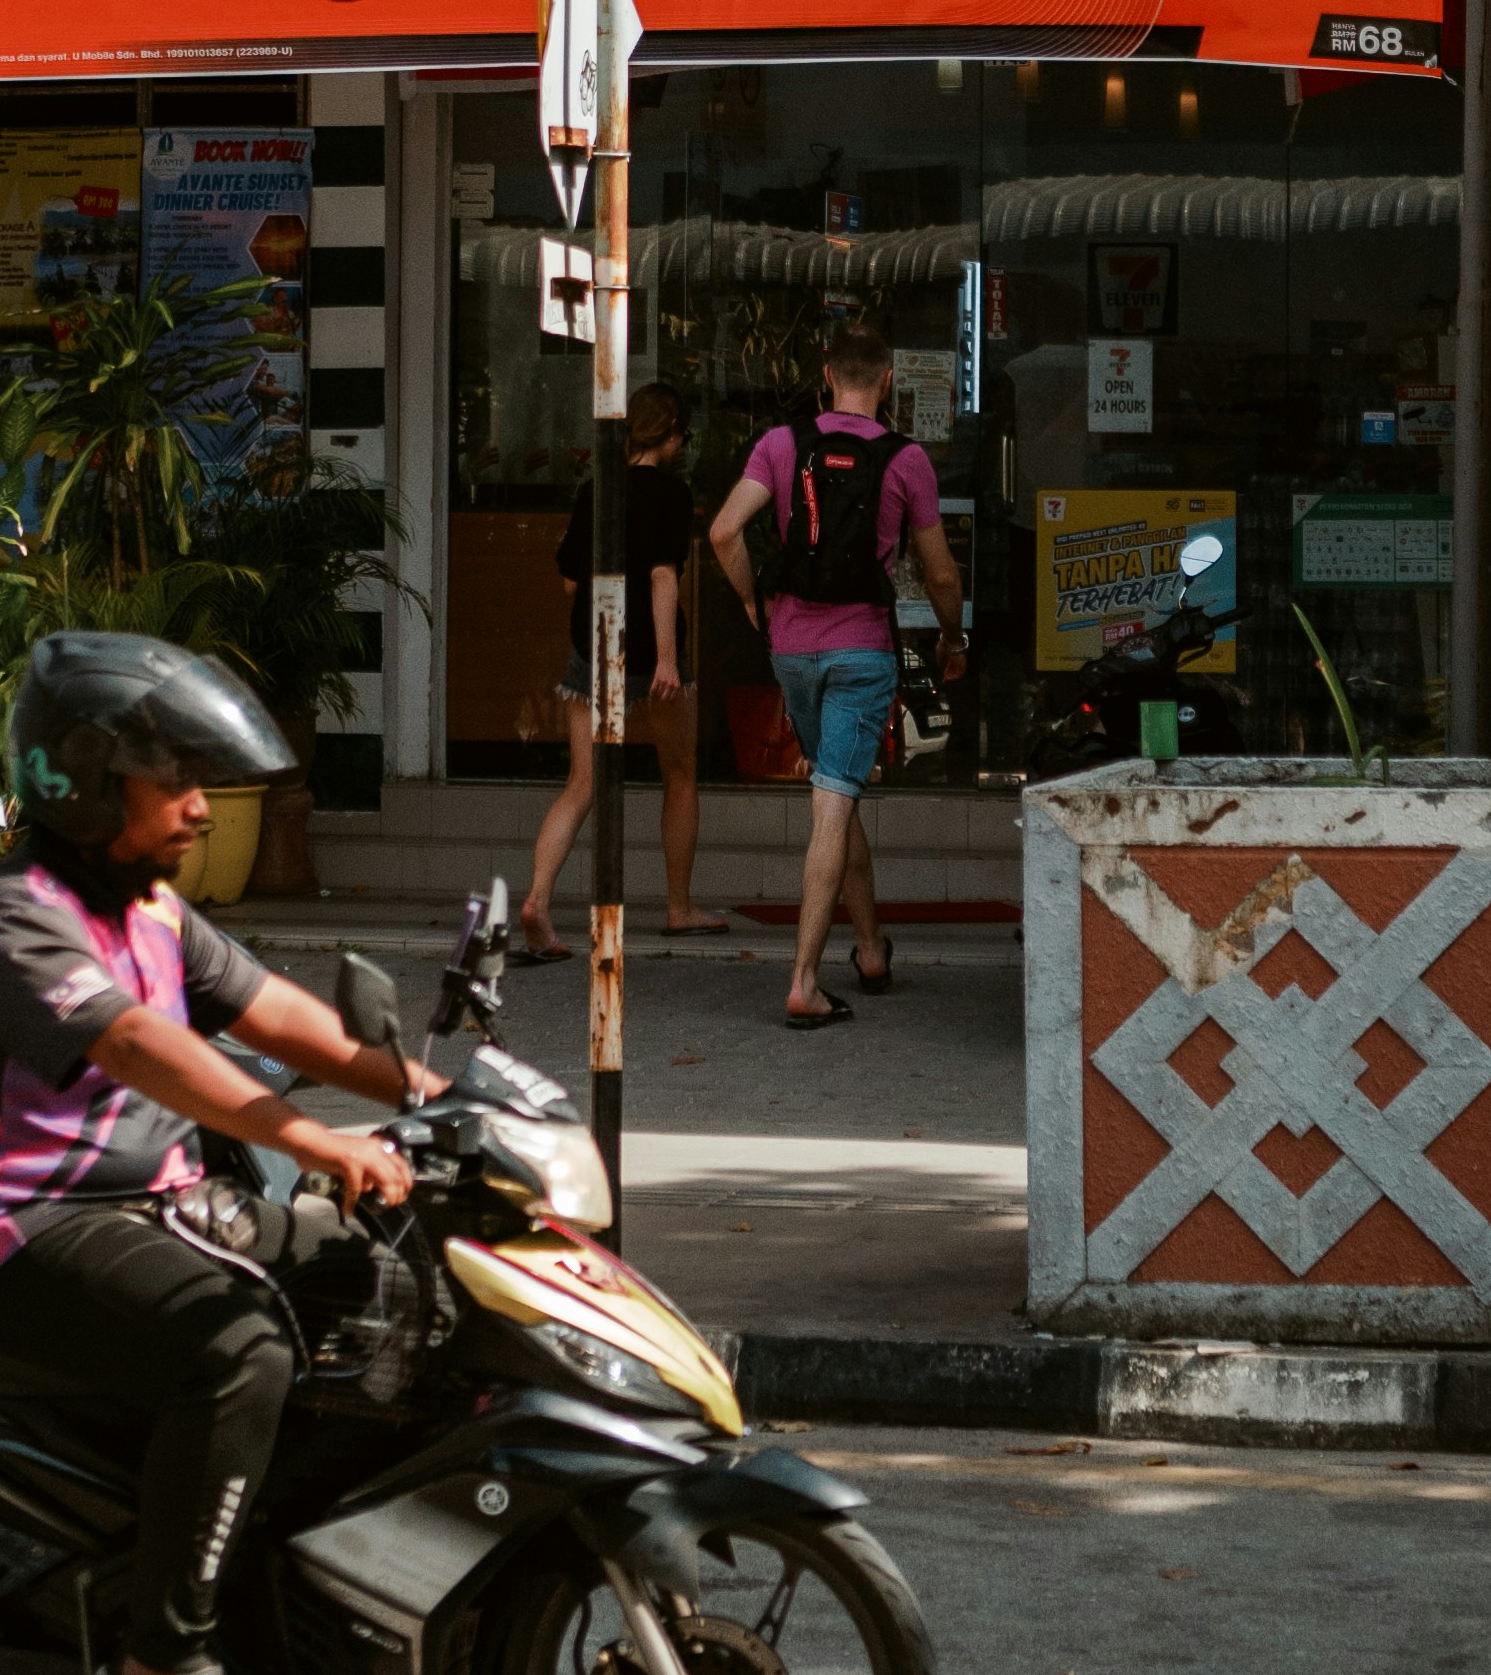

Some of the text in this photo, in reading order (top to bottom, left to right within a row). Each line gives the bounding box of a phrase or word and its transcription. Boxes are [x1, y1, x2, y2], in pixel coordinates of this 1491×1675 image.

[1332, 39, 1356, 52] RM
[1359, 25, 1403, 56] 68
[17, 53, 36, 63] dan
[82, 51, 115, 61] Mobile
[194, 139, 248, 163] BOOK
[177, 173, 308, 192] AVANTE SUNSET
[153, 192, 281, 211] DINNER CRUISE!
[26, 221, 36, 232] A
[991, 279, 1003, 332] TOLAK
[1104, 379, 1134, 394] OPEN
[1094, 400, 1147, 414] 24 HOURS
[1054, 539, 1110, 560] INTERNET
[1121, 525, 1188, 549] PANGGILAN
[1053, 549, 1146, 592] TANPA
[1055, 573, 1181, 620] TERHEBAT!
